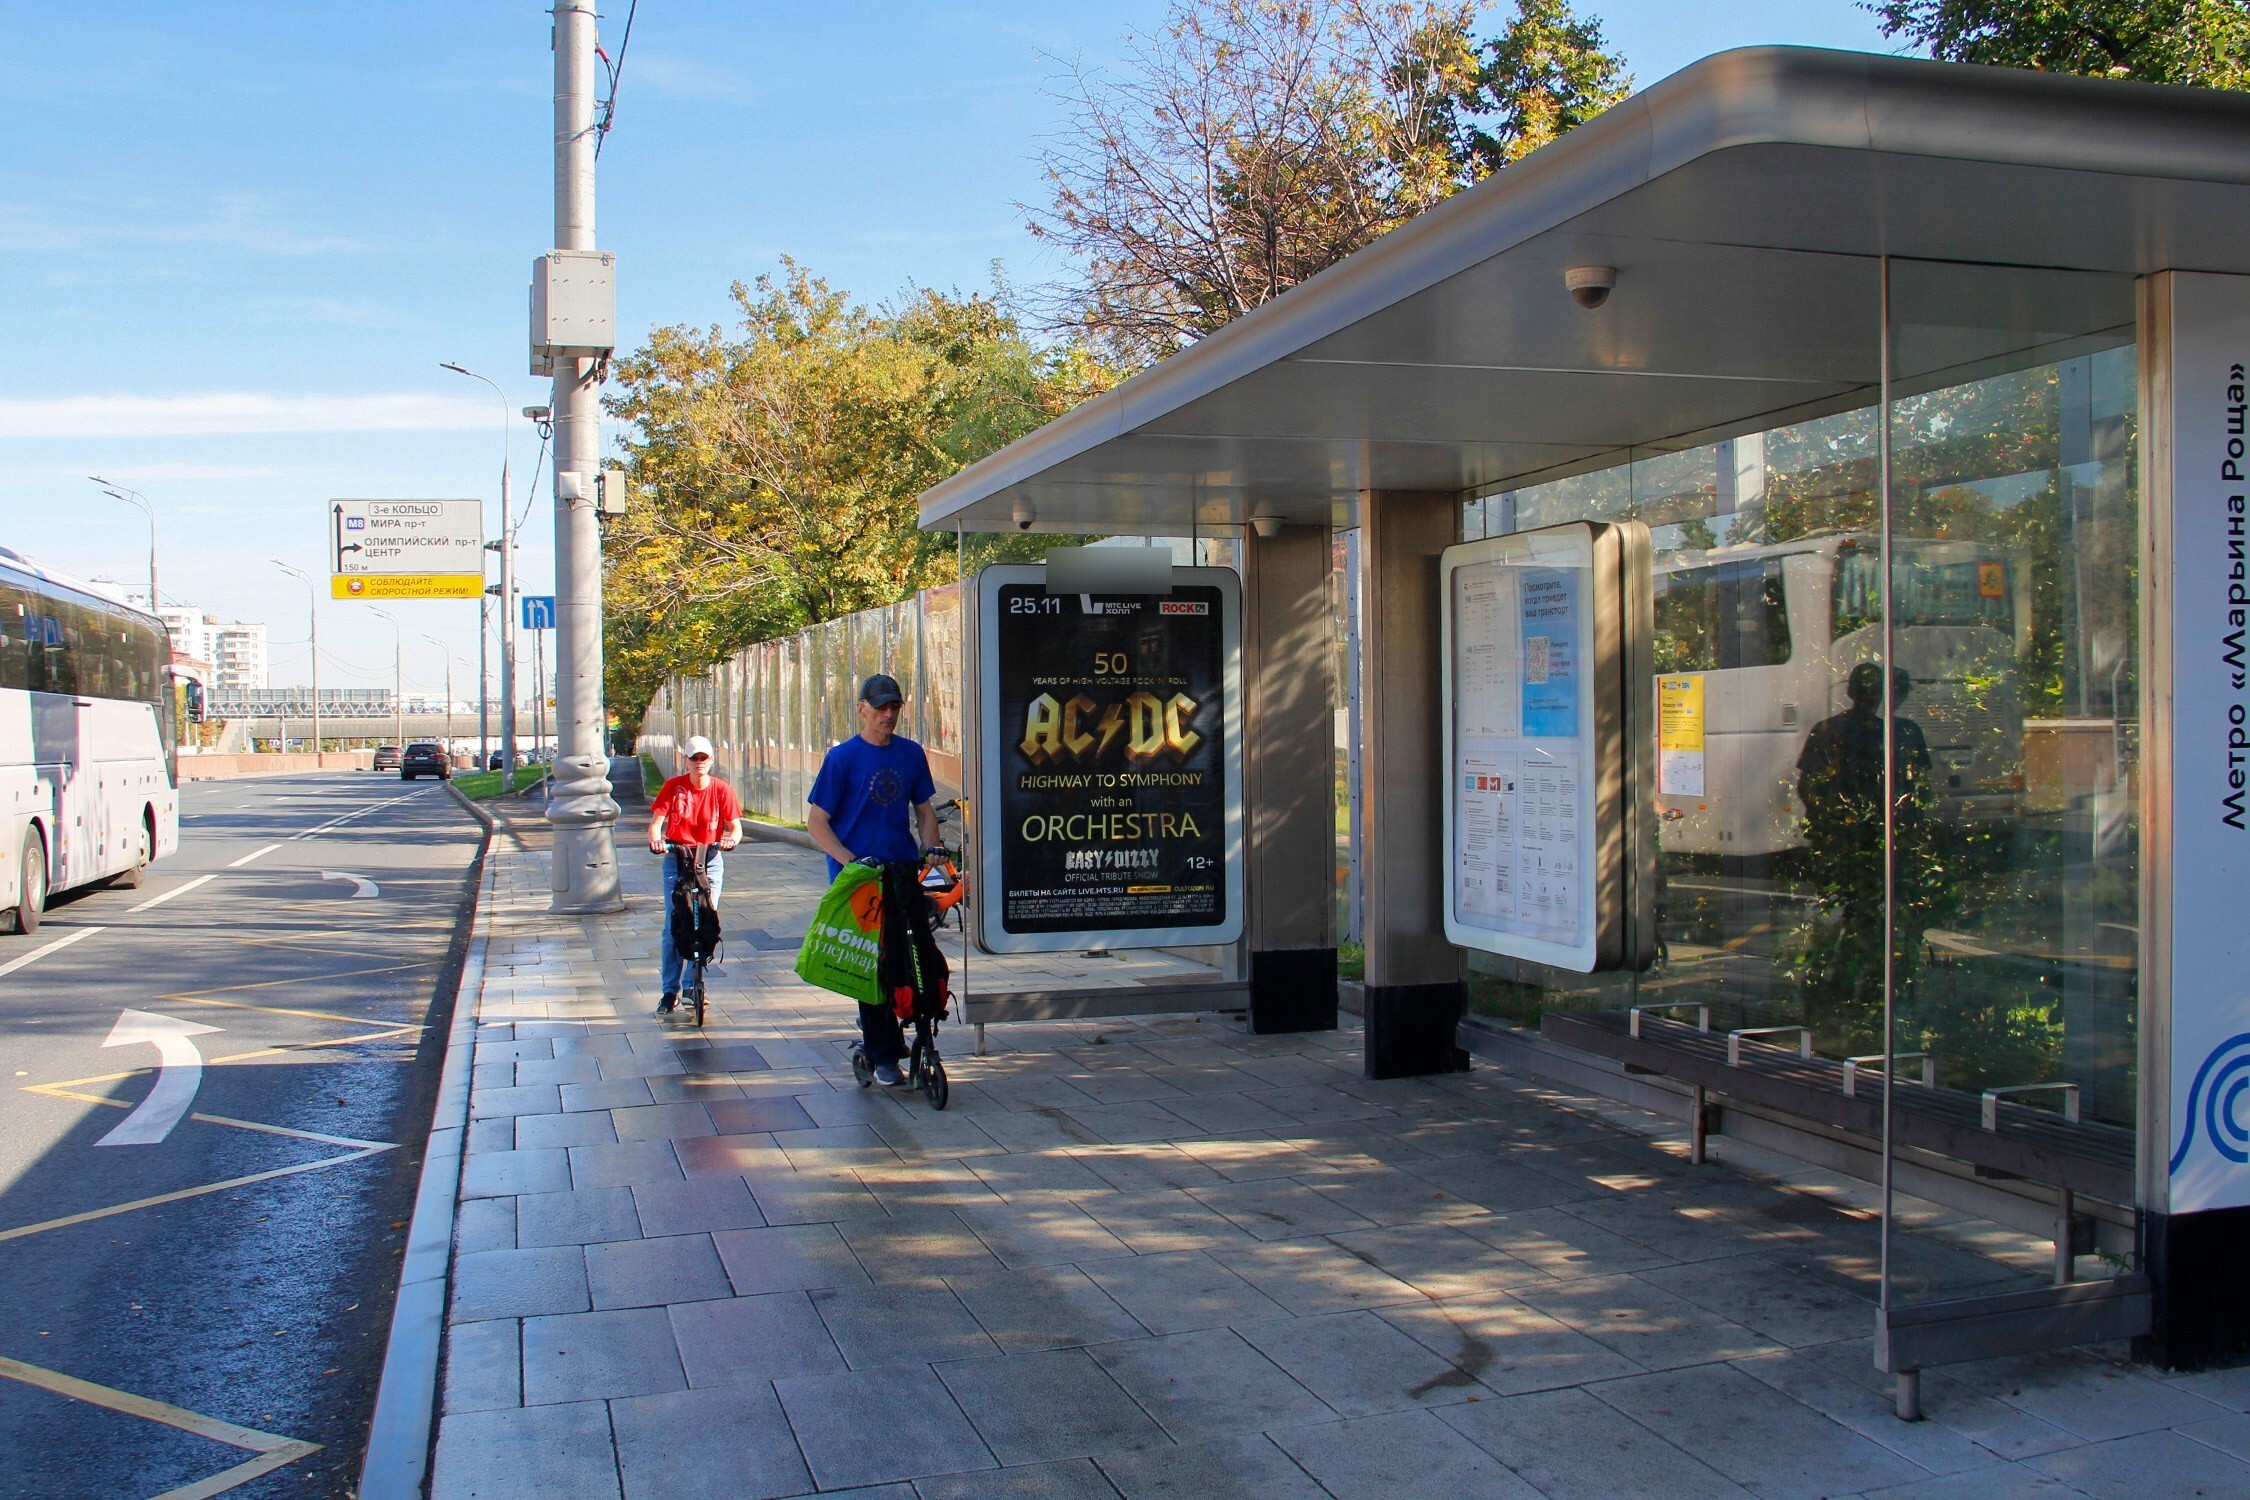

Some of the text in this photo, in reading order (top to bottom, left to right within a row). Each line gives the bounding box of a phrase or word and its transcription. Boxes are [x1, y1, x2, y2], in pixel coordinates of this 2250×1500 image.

[373, 505, 438, 515] 3-е КОЛЬЦО
[370, 519, 427, 530] МИРА пр-т
[364, 537, 477, 547] ОЛИМПИЙСКИЙ пр-т
[365, 549, 401, 558] ЦЕНТР
[344, 563, 359, 571] 150
[370, 577, 433, 586] СОБЛЮДАЙТЕ
[1524, 580, 1562, 592] Посмотрите,
[370, 586, 469, 595] СКОРОСТНОЙ РЕЖИМ!
[1525, 592, 1567, 605] когда приедет
[2221, 363, 2250, 831] Метро «Марьина Роща»
[1010, 597, 1061, 614] 25.11
[1525, 605, 1568, 618] ваш транспорт
[1094, 652, 1128, 674] 50
[1032, 677, 1057, 685] YEARS
[1059, 677, 1071, 685] OF
[1072, 677, 1093, 685] HIGH
[1096, 677, 1131, 685] VOLTAGE
[1133, 677, 1155, 685] ROCK
[1168, 677, 1188, 685] ROLL
[1021, 773, 1203, 788] HIGHWAY TO SYMPHONY
[1091, 796, 1132, 807] with an
[1022, 812, 1201, 842] ORCHESTRA
[1187, 856, 1214, 869] 12+
[1065, 871, 1159, 882] OFFICIAL TRIBUTE SHOW
[1009, 889, 1040, 897] БИЛЕТЫ
[1052, 887, 1077, 896] САЙТЕ
[1078, 886, 1124, 895] LIVE.MTS.RU
[860, 896, 882, 924] Я
